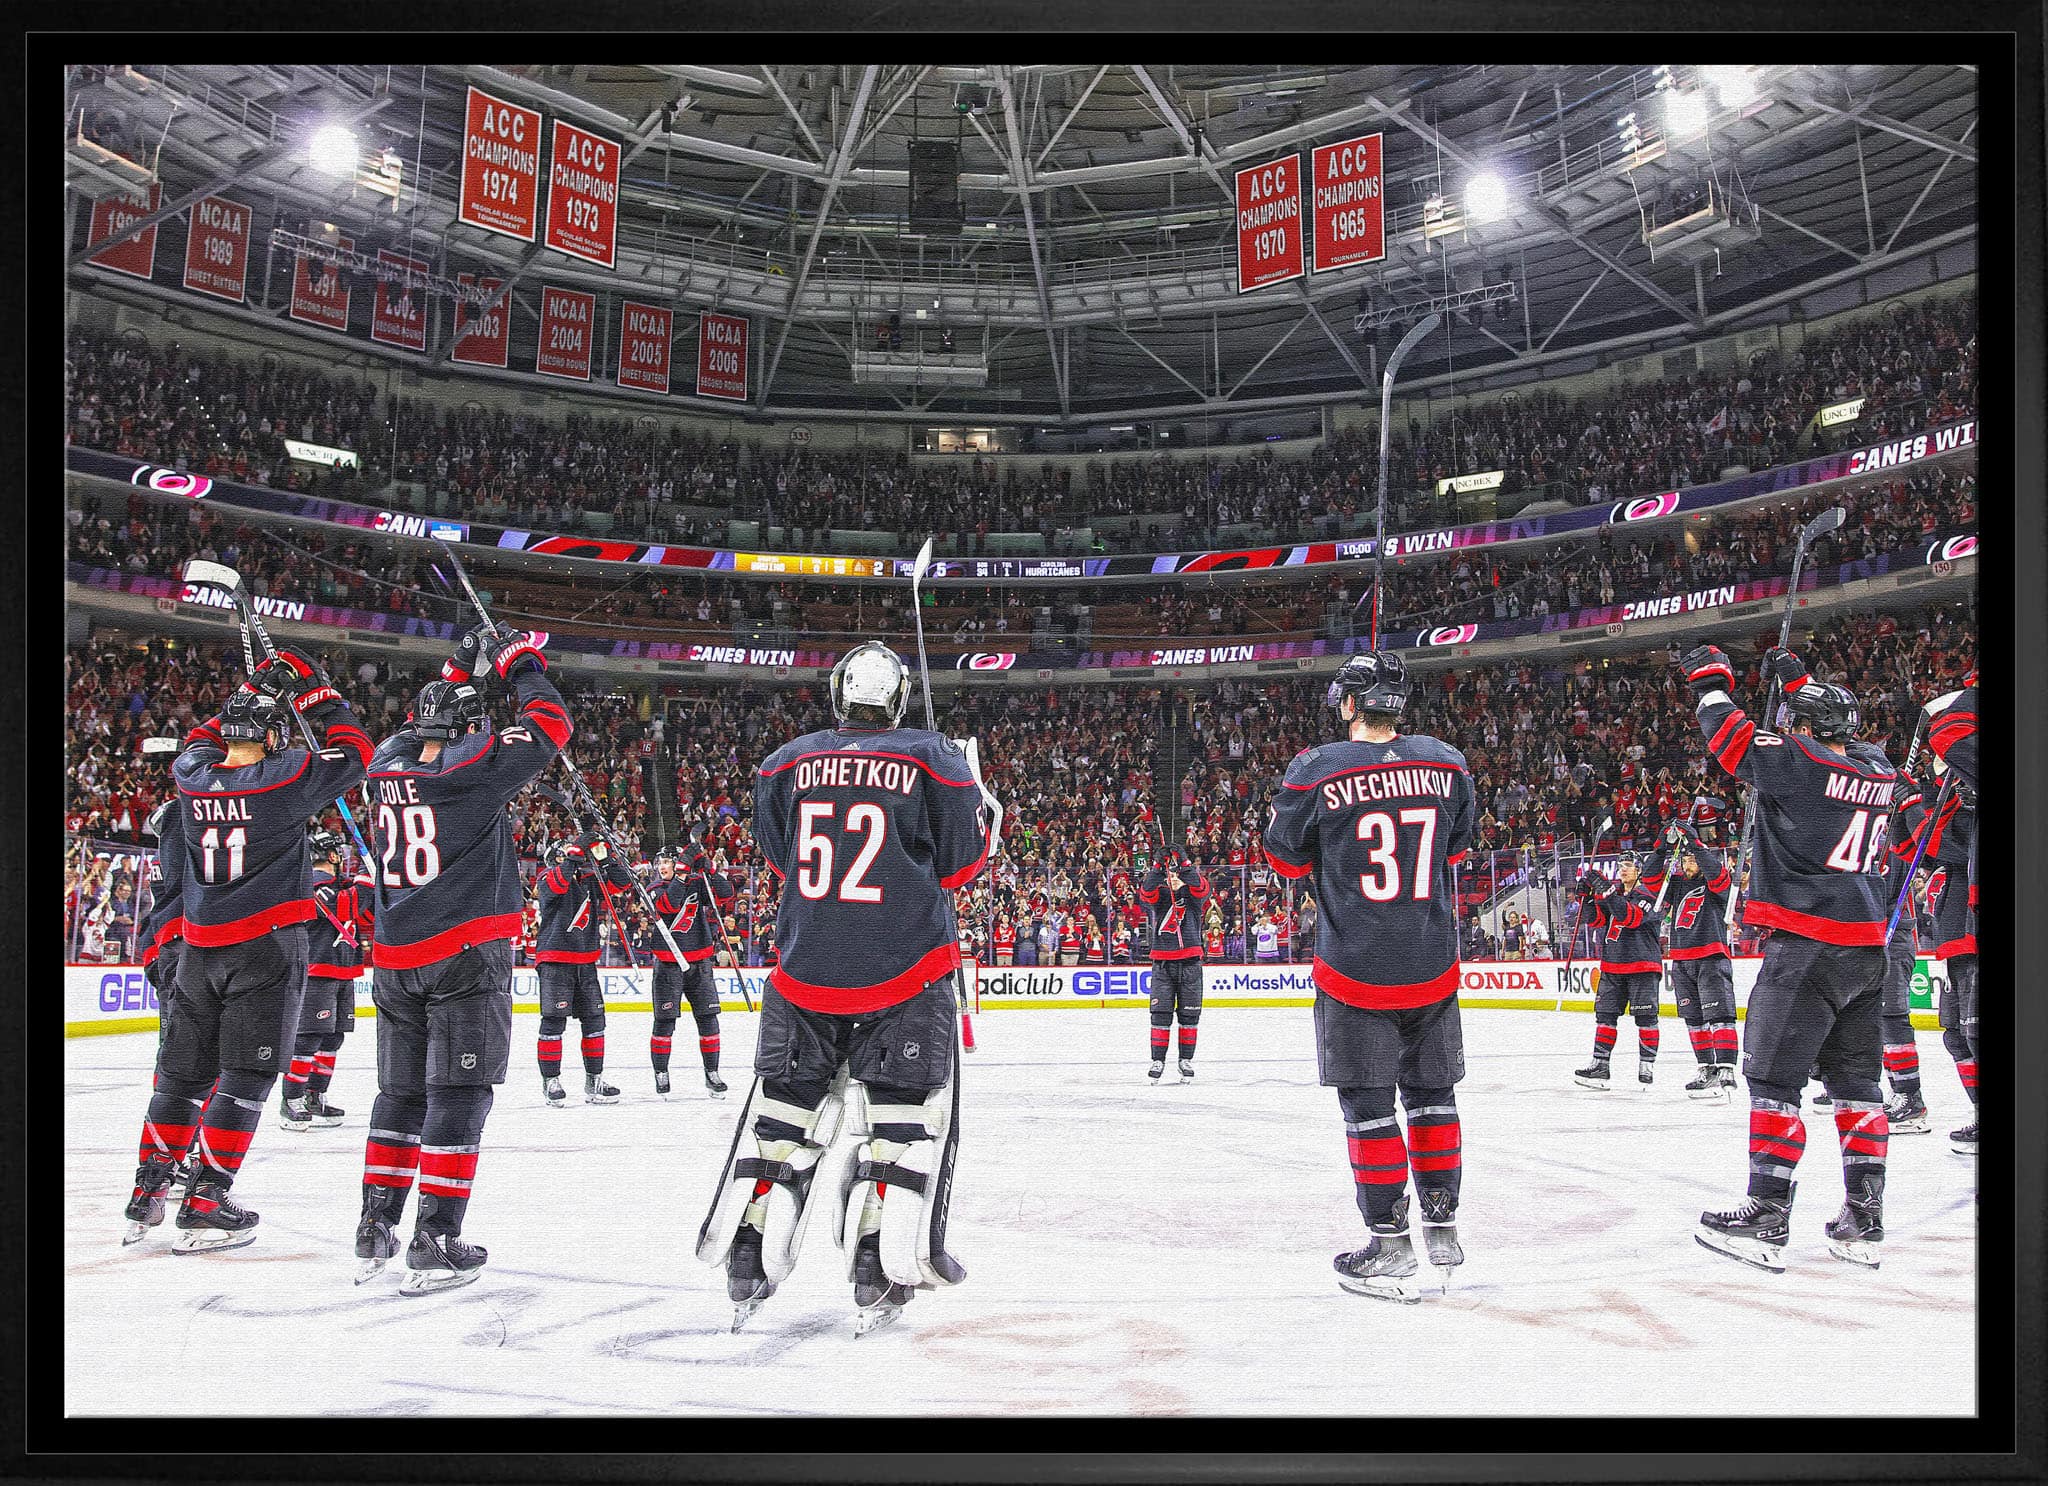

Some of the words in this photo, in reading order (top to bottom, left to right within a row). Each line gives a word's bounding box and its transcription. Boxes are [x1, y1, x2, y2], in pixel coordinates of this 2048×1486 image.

[483, 104, 525, 142] ACC
[469, 135, 534, 176] CHAMPIONS
[567, 135, 606, 172] ACC
[1328, 144, 1367, 179] ACC
[483, 168, 518, 205] 1974
[555, 164, 614, 204] CHAMPIONS
[1250, 166, 1286, 201] ACC
[1317, 175, 1379, 209] CHAMPIONS
[199, 201, 241, 235] NCAA
[477, 213, 521, 231] TOURNAMENT
[567, 197, 599, 232] 1973
[1240, 195, 1297, 230] CHAMPIONS
[1331, 207, 1366, 241] 1965
[204, 234, 233, 266] 1989
[561, 239, 601, 257] TOURNAMENT
[1254, 227, 1286, 261] 1970
[1330, 250, 1369, 263] TOURNAMENT
[188, 268, 211, 284] SWEET
[550, 297, 587, 323] NCAA
[629, 312, 665, 337] NCAA
[707, 321, 741, 346] NCAA
[551, 325, 582, 352] 2004
[631, 340, 662, 365] 2005
[709, 349, 738, 374] 2006
[621, 367, 642, 380] SWEET
[1823, 408, 1848, 420] UNC
[1850, 435, 1928, 474] CANES
[1936, 422, 1978, 452] WI
[1458, 480, 1473, 489] NC
[1342, 543, 1371, 554] 10:00
[1404, 531, 1453, 553] WIN
[873, 561, 883, 576] 2
[936, 563, 946, 576] 5
[1004, 568, 1009, 576] 1
[1025, 567, 1080, 576] HURRICANES
[254, 596, 305, 620] WIN
[1622, 596, 1682, 621] CANES
[1687, 585, 1735, 611] WIN
[1608, 624, 1622, 633] 129
[689, 645, 746, 664] CANES
[750, 649, 795, 665] WIN
[1151, 649, 1206, 666] CANES
[1210, 645, 1254, 662] WIN
[423, 703, 436, 717] 28
[1385, 694, 1400, 708] 37
[230, 725, 240, 737] 11
[379, 778, 420, 805] COLE
[1323, 768, 1453, 811] SVECHNIKOV
[192, 797, 252, 822] STAAL
[201, 825, 247, 884] 11
[378, 804, 441, 888] 28
[798, 801, 887, 904] 52
[1356, 806, 1438, 902] 37
[514, 975, 540, 995] UN
[604, 975, 642, 995] EX
[1234, 973, 1314, 990] MassMut
[1756, 1226, 1789, 1239] CCM
[1836, 1223, 1849, 1233] CCM
